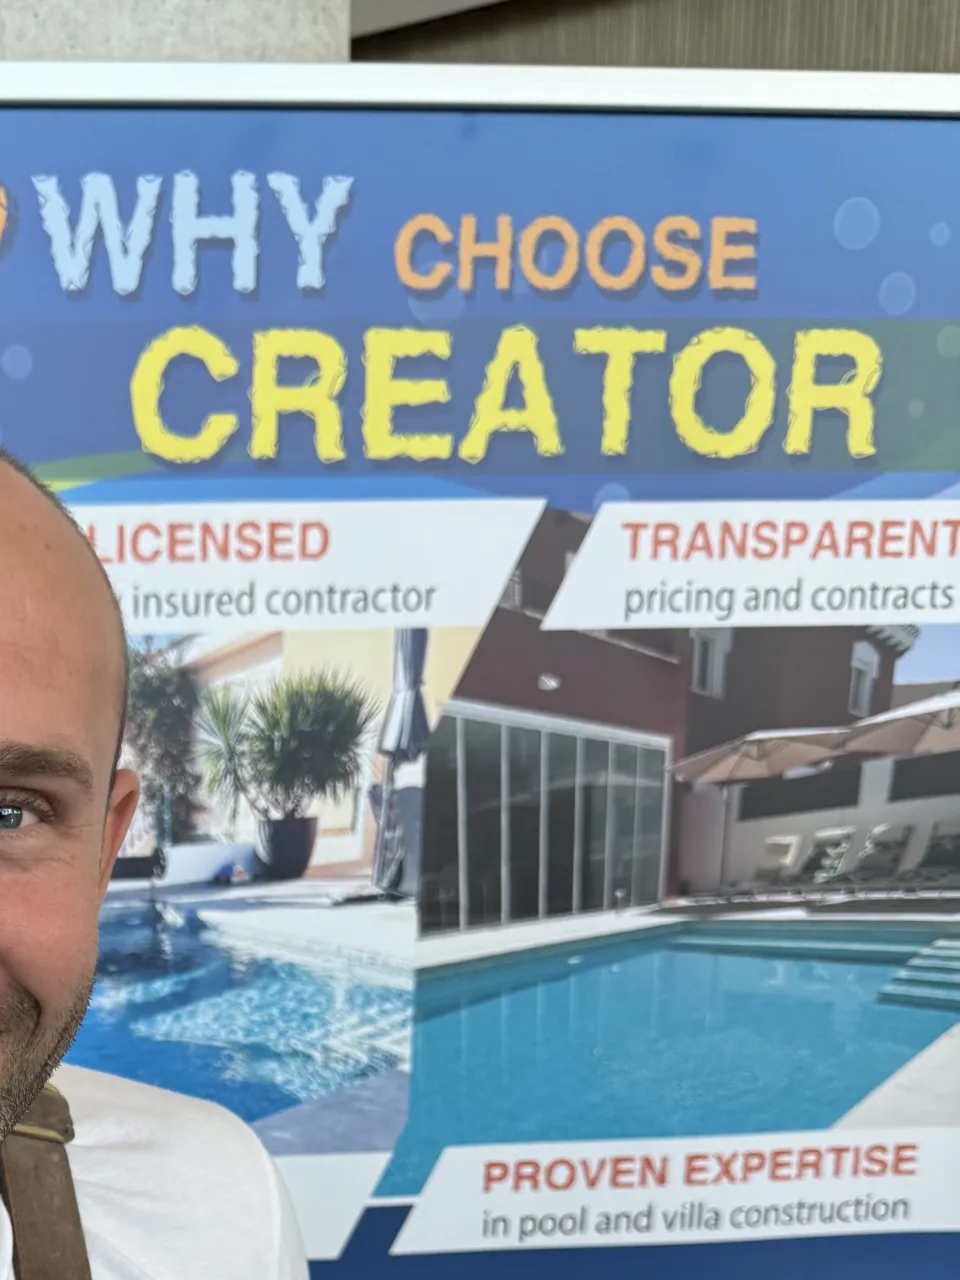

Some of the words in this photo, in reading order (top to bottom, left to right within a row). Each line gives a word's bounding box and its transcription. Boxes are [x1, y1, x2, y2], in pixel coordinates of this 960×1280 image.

[31, 169, 354, 294] WHY
[395, 214, 758, 291] CHOOSE
[130, 325, 882, 463] CREATOR
[88, 520, 331, 565] LICENSED
[622, 519, 960, 561] TRANSPARENT
[133, 579, 256, 619] insured
[265, 582, 436, 615] contractor
[624, 579, 734, 622] pricing
[743, 577, 803, 612] and
[811, 580, 954, 612] contracts
[482, 1155, 669, 1194] PROVEN
[683, 1143, 919, 1186] EXPERTISE
[482, 1208, 510, 1238] in
[518, 1205, 588, 1242] pool
[595, 1202, 653, 1236] and
[661, 1200, 721, 1232] villa
[728, 1192, 910, 1230] construction
